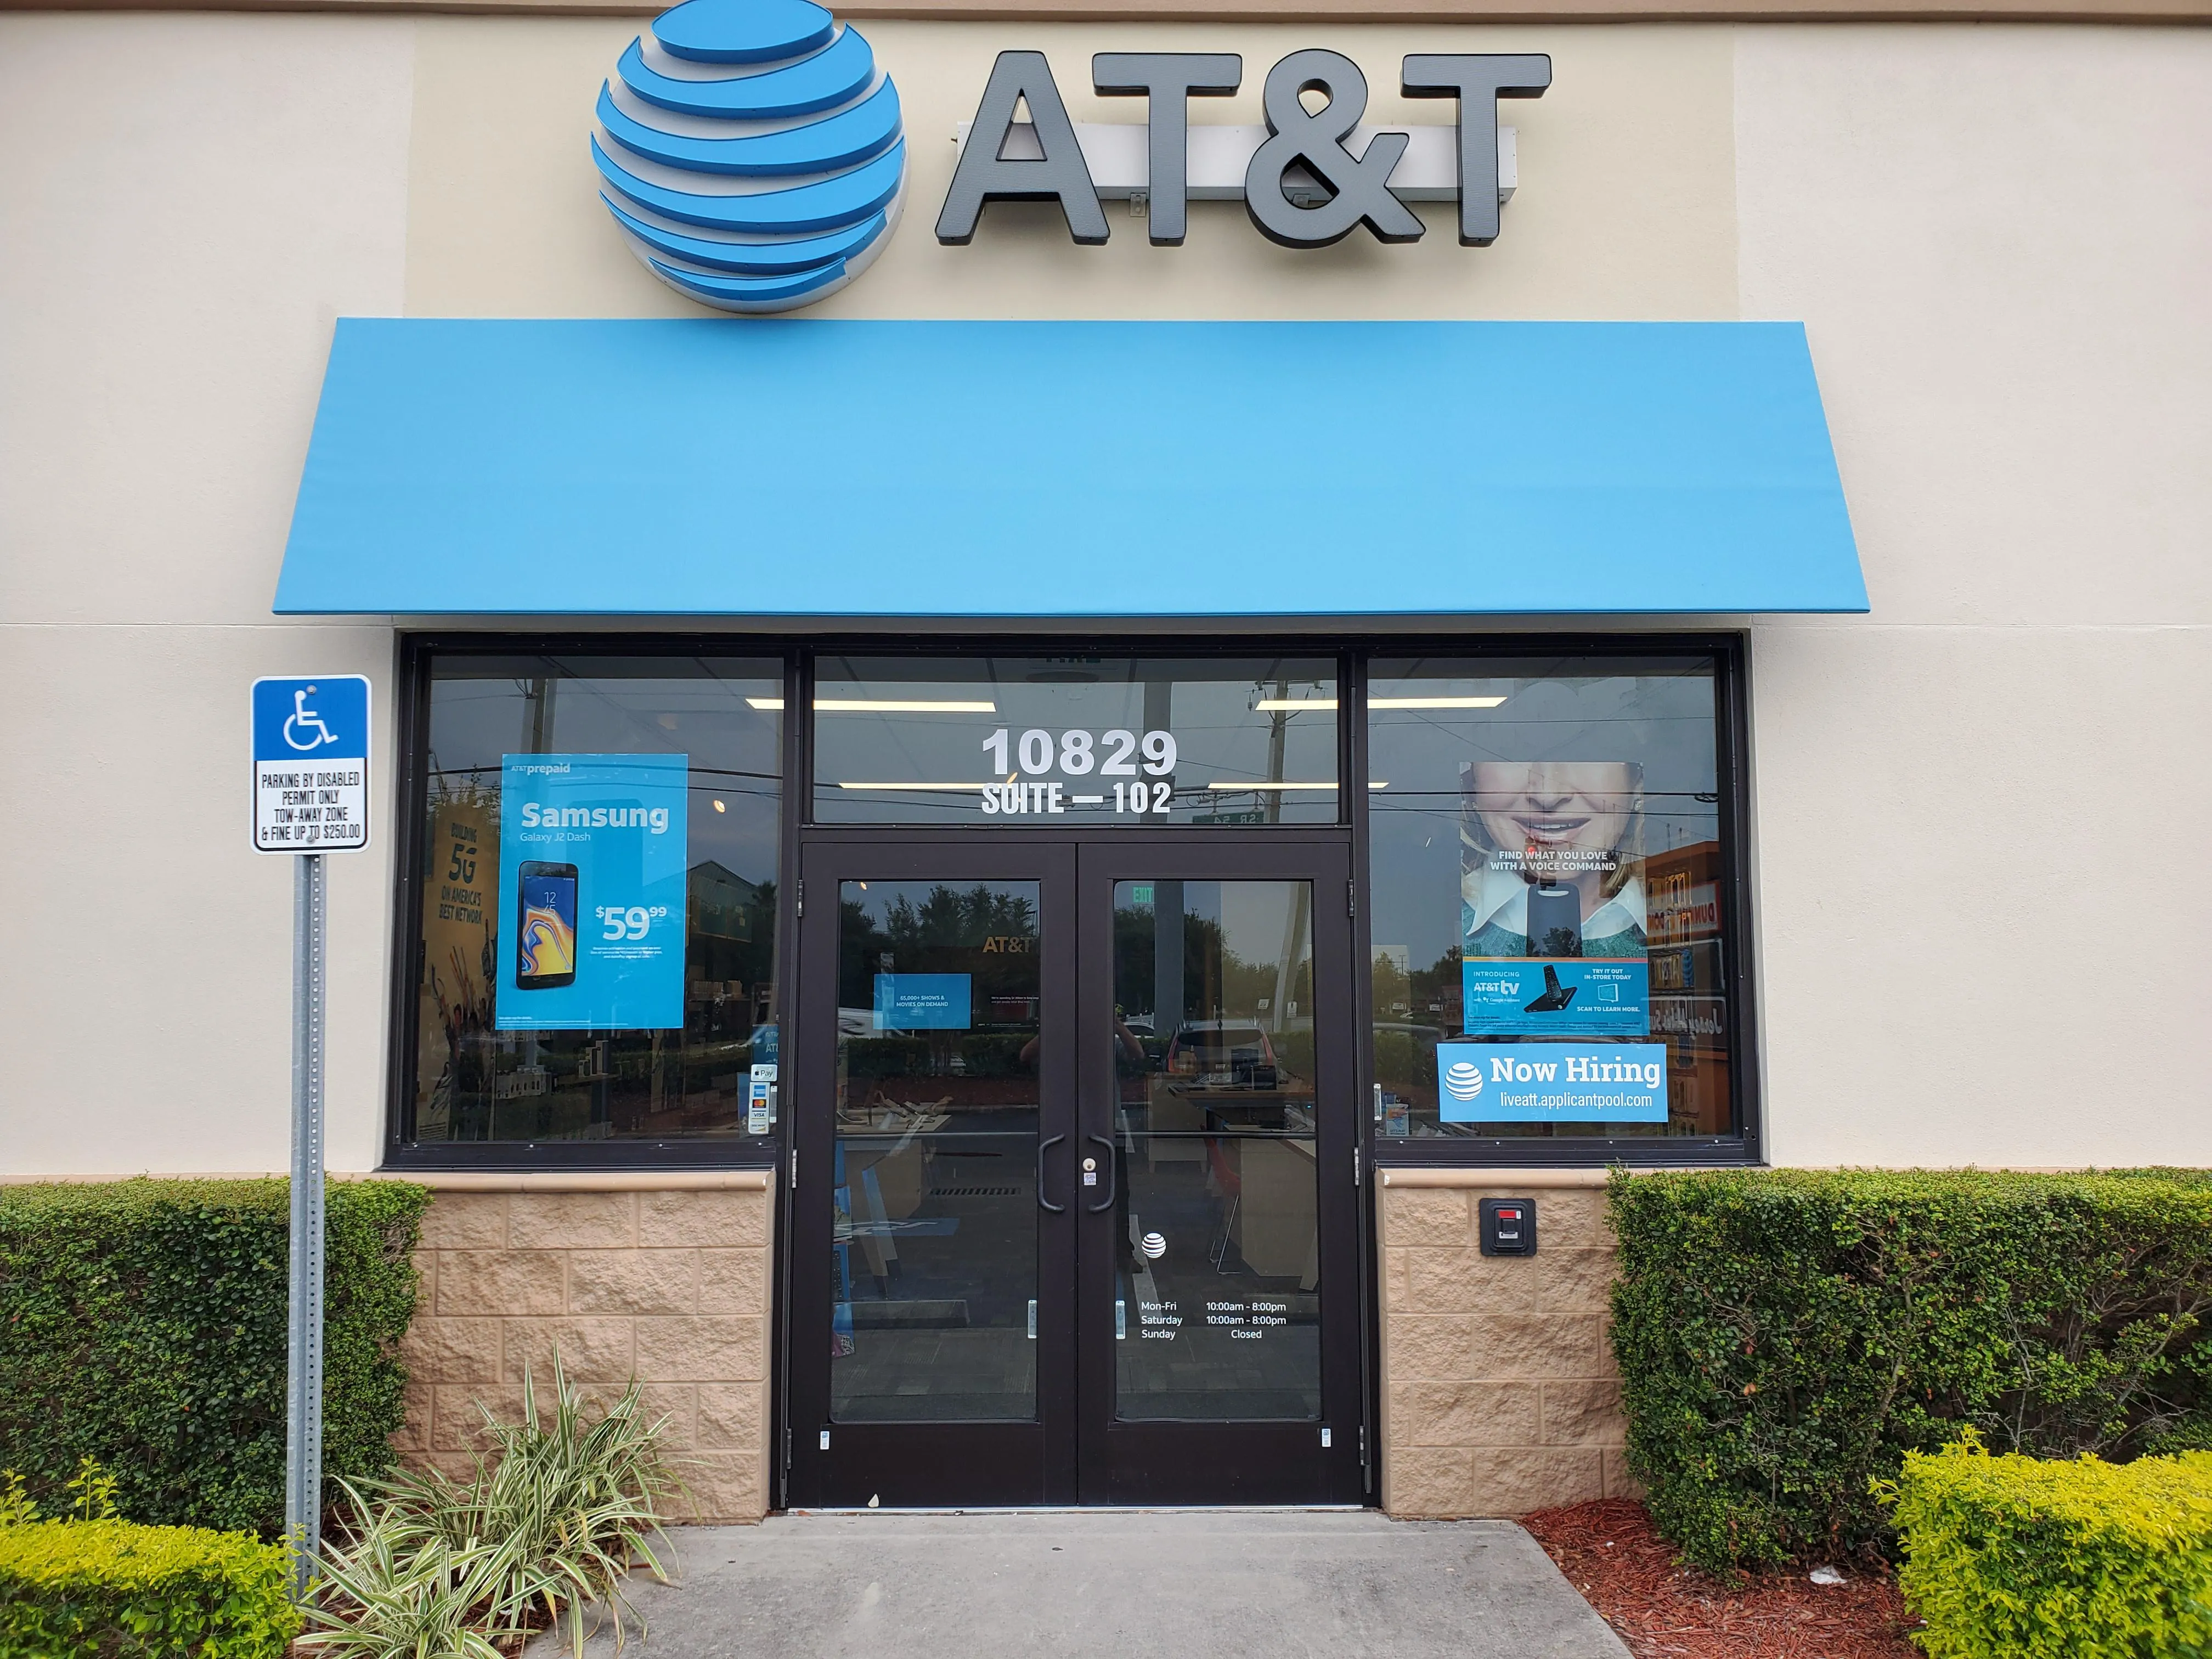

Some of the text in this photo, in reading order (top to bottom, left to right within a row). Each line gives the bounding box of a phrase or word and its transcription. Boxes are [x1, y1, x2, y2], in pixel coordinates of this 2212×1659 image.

[934, 48, 1553, 249] AT&T
[983, 729, 1177, 775] 10829
[527, 763, 571, 775] prepaid
[262, 771, 359, 788] PARKING BY DISABLED
[282, 789, 340, 805] PERMIT ONLY
[981, 782, 1064, 814] SUITE
[1113, 782, 1171, 814] 102
[274, 806, 348, 823] TOW-AWAY ZONE
[522, 803, 669, 834] Samsung
[262, 824, 360, 840] & FINE UP TO $250.00
[520, 832, 591, 843] Galaxy J2 Dash
[449, 843, 477, 884] 5G
[1499, 851, 1607, 860] FIND WHAT YOU LOVE
[1490, 862, 1616, 871] WITH A VOICE COMMAND
[544, 891, 556, 904] 12
[1133, 887, 1153, 902] EXIT
[439, 904, 454, 920] BEST
[983, 936, 1031, 953] AT&T
[1474, 979, 1520, 995] AT&T tv
[1490, 1056, 1660, 1088] Now Hiring
[1500, 1092, 1652, 1110] liveatt.applicantpool.com
[1141, 1301, 1177, 1311] Mon-Fri
[1206, 1302, 1244, 1312] 10:00am
[1252, 1302, 1286, 1313] 8:00pm
[1141, 1316, 1183, 1327] Saturday
[1206, 1316, 1244, 1325] 10:00am
[1252, 1316, 1286, 1327] 8:00pm
[1141, 1330, 1176, 1340] Sunday
[1231, 1330, 1262, 1339] Closed
